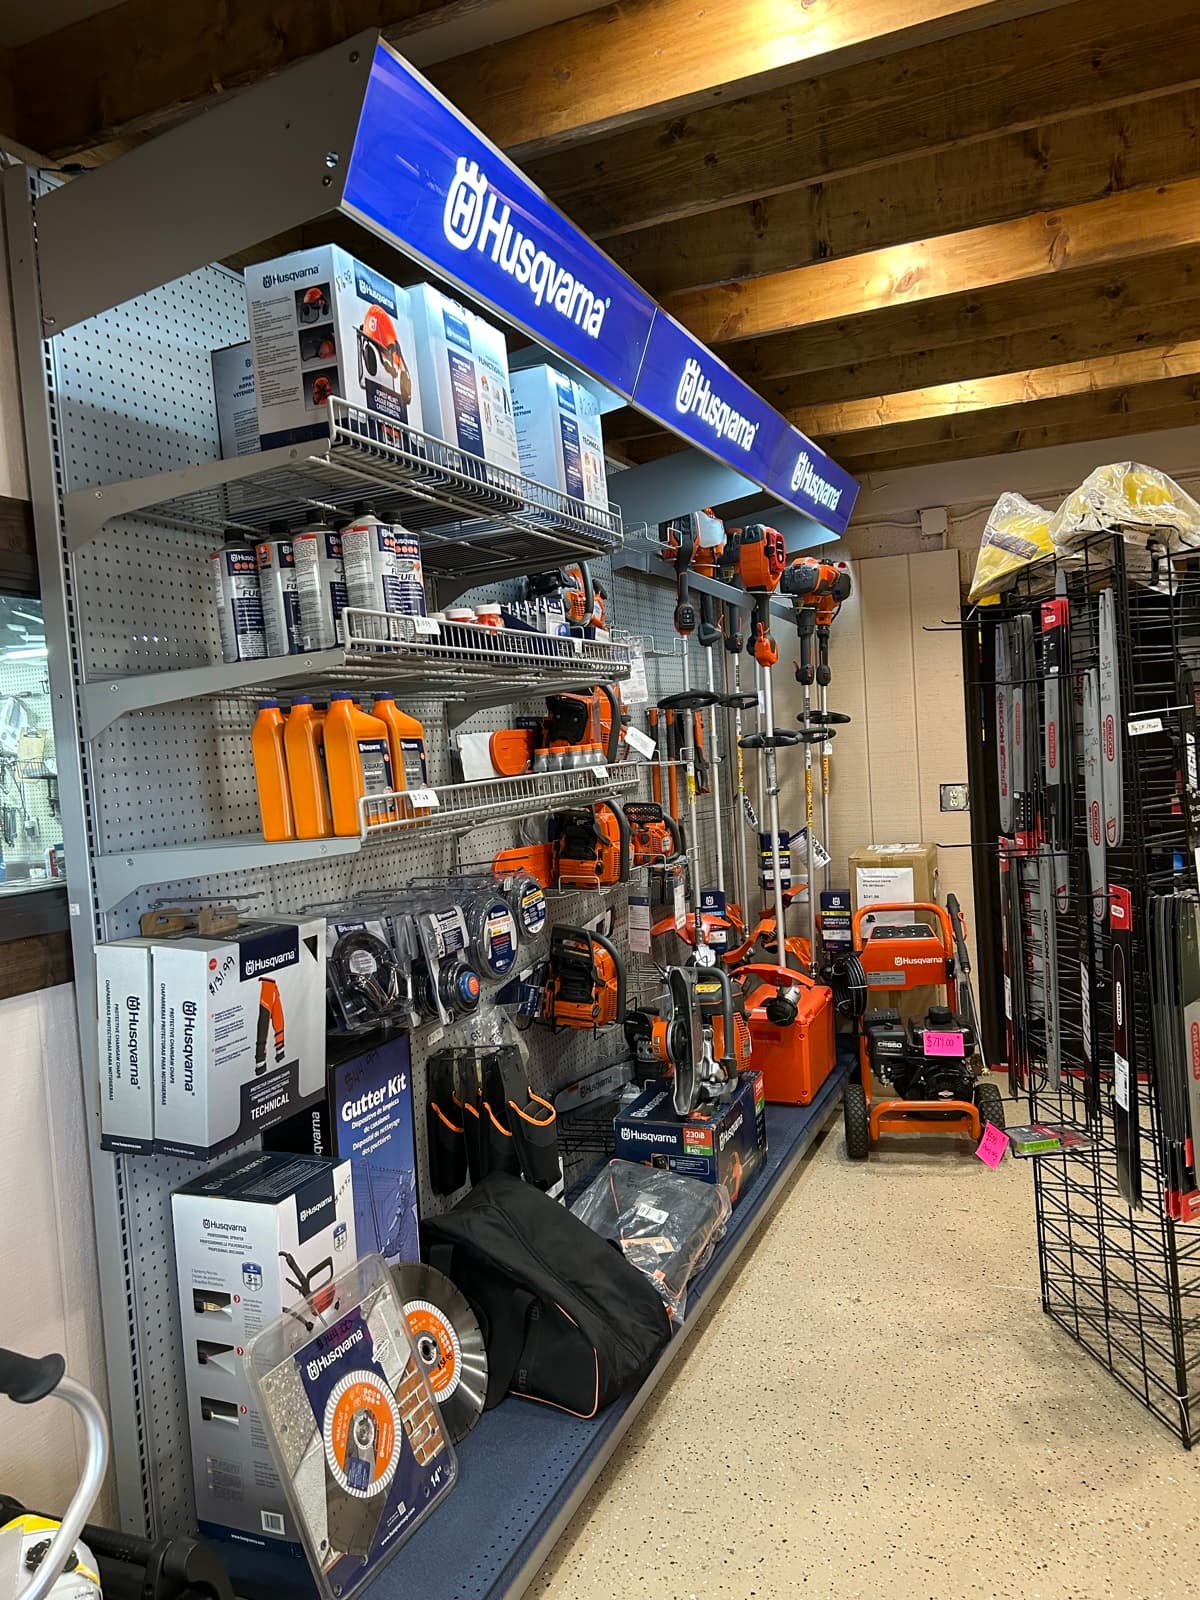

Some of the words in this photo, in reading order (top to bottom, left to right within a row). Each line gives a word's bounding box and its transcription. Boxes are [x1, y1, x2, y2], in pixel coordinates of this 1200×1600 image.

[272, 264, 320, 285] Husqvarna
[475, 192, 608, 339] Husqvarna
[366, 284, 395, 310] Husqvarna
[694, 382, 758, 453] Husqvarna
[803, 468, 842, 512] Husqvarna
[1186, 733, 1198, 780] ECHO
[255, 950, 295, 972] Husqvarna
[903, 957, 943, 965] Husqvarna
[128, 1012, 139, 1086] Husqvarna
[182, 1017, 195, 1091] Husqvarna
[250, 1093, 290, 1120] TECHNICAL
[342, 1086, 387, 1121] Gutter
[388, 1072, 407, 1098] Kit
[631, 1130, 677, 1144] Husqvarna
[306, 1196, 333, 1217] Husqvarna
[211, 1221, 247, 1233] Husqvarna
[317, 1329, 364, 1372] Husqvarna
[430, 1465, 442, 1487] 14"
